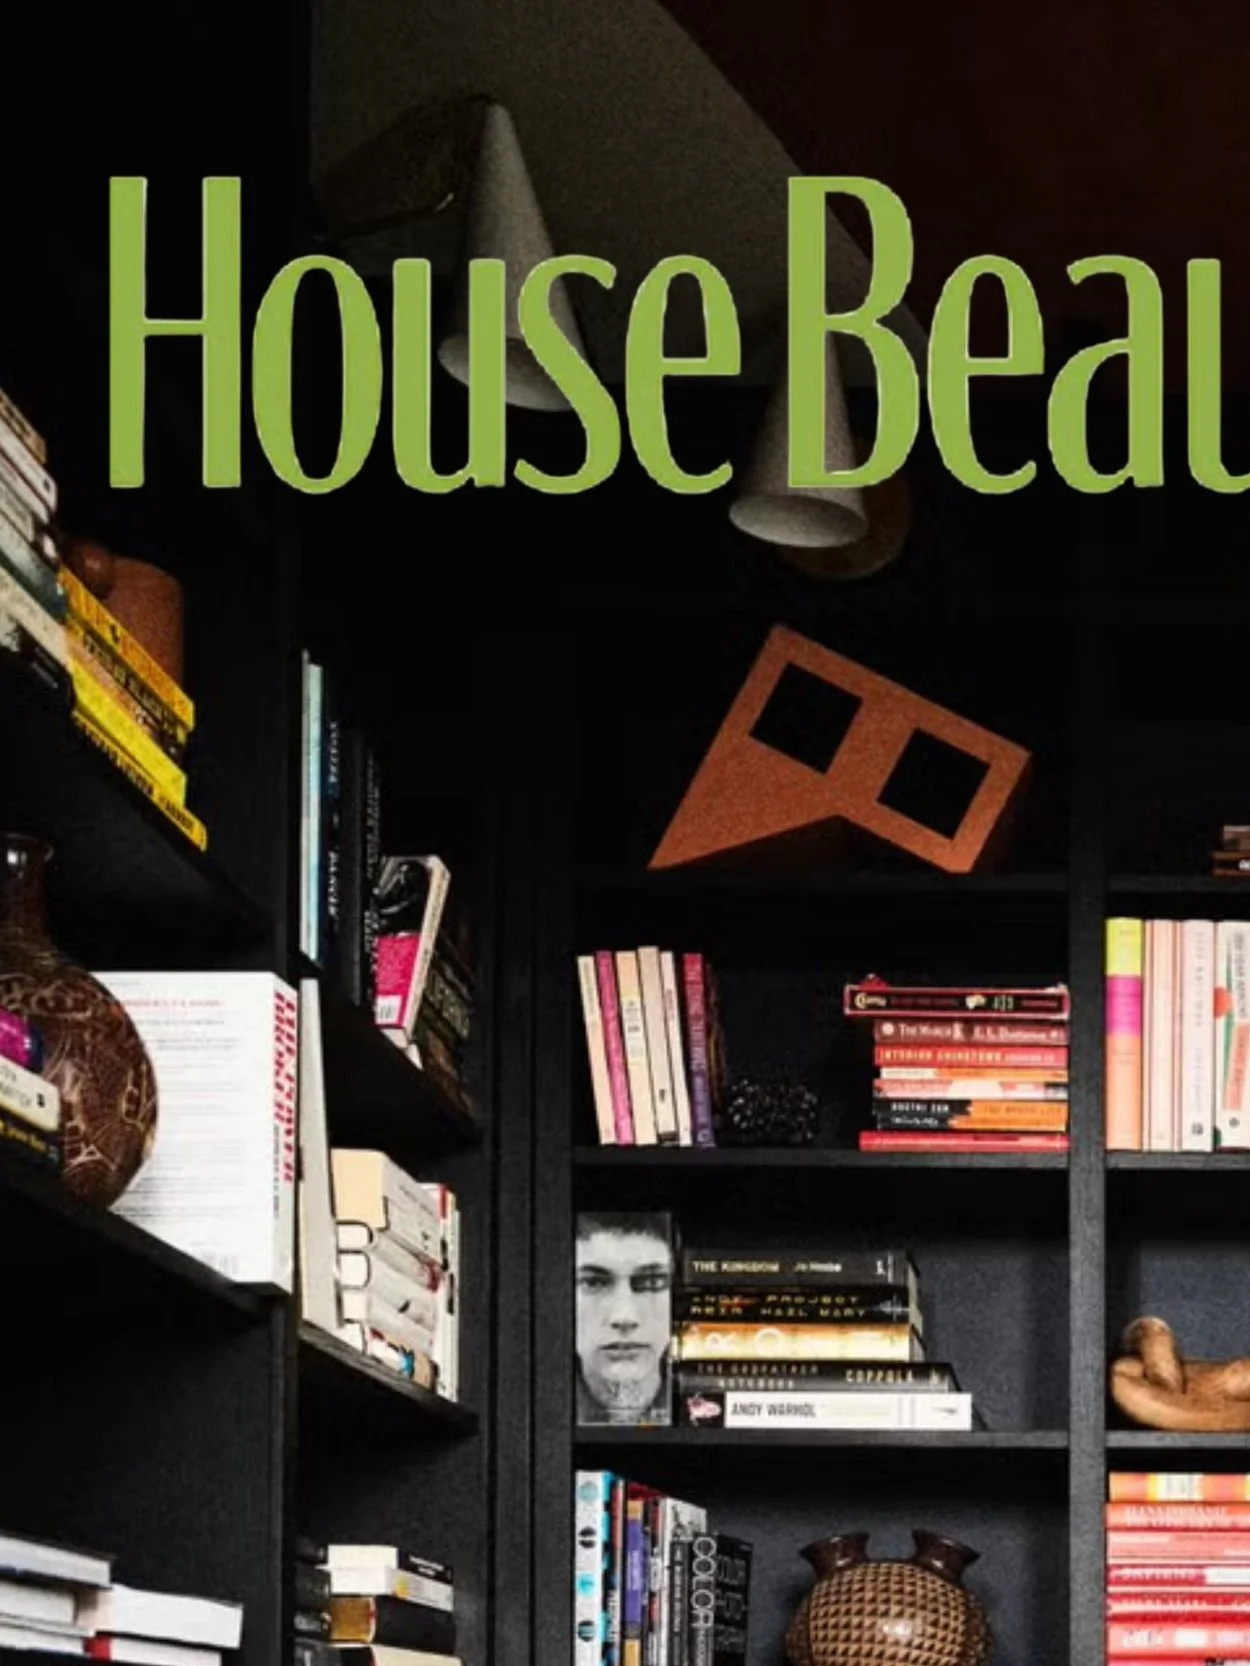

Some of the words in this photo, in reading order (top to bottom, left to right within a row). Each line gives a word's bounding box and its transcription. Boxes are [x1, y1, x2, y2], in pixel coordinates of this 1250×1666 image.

[692, 1261, 718, 1273] THE
[721, 1261, 780, 1273] KINGDOM
[731, 1402, 766, 1418] ANDY
[692, 1536, 717, 1628] COLOR
